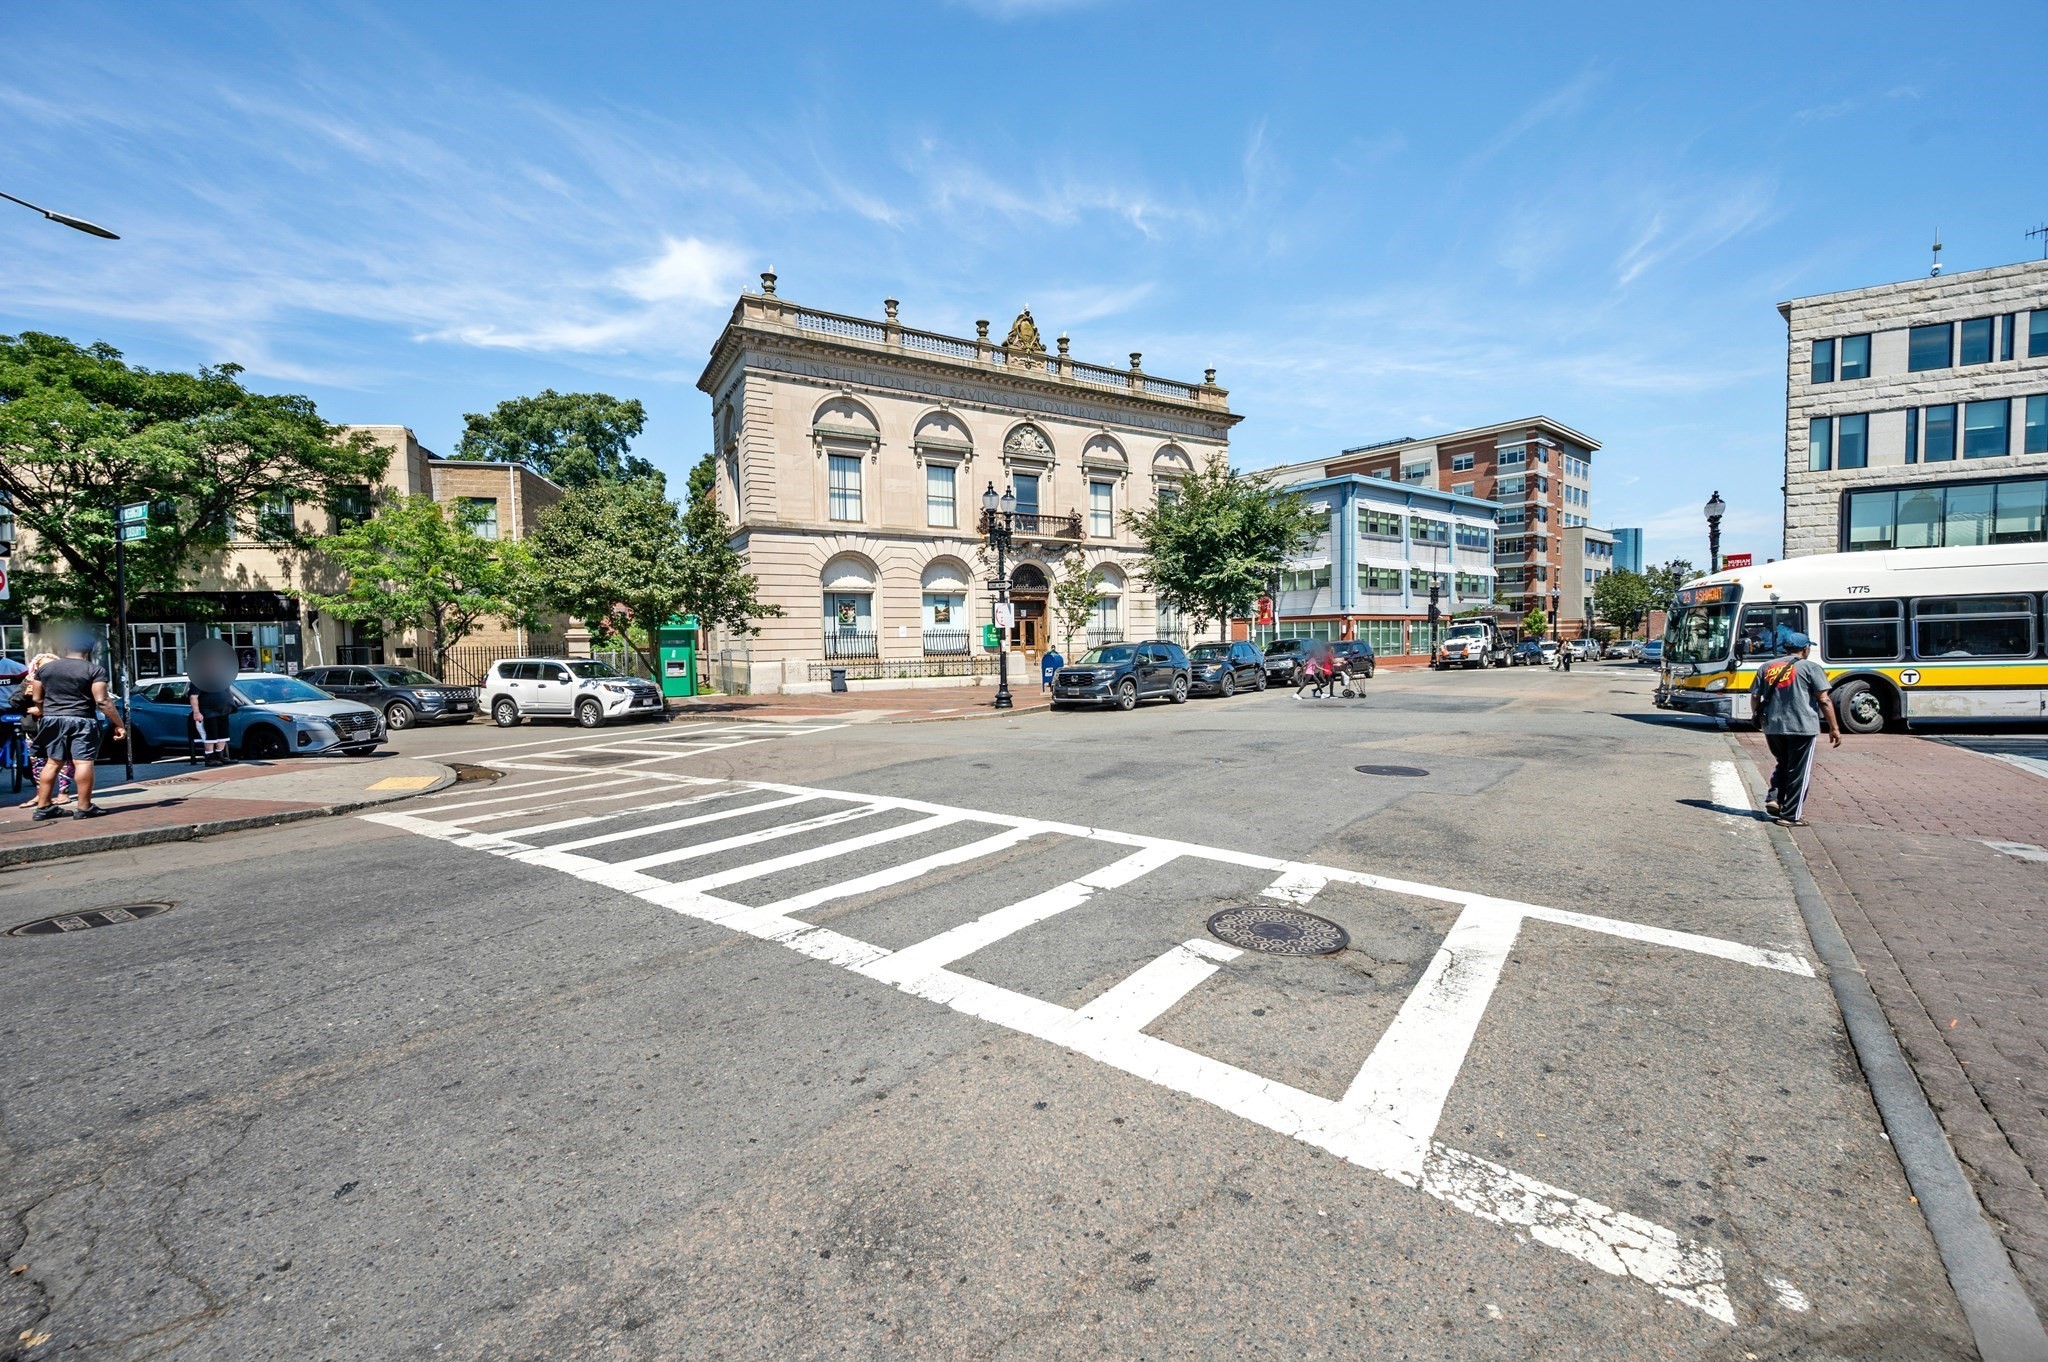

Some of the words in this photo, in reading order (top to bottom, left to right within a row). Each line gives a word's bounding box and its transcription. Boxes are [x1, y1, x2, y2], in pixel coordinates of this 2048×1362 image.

[757, 355, 793, 372] 1825
[804, 363, 906, 389] INSTITUTION
[915, 380, 941, 394] FOR
[951, 386, 1009, 404] SAVINGS
[1017, 396, 1029, 408] IN
[1038, 401, 1093, 419] ROXBURY
[1099, 412, 1121, 424] AND
[1127, 415, 1144, 425] ITS
[1151, 419, 1196, 434] VICINITY
[1682, 591, 1691, 604] 23
[1694, 587, 1723, 603] ASHMONT
[1846, 585, 1870, 594] 1775
[1903, 673, 1917, 683] T
